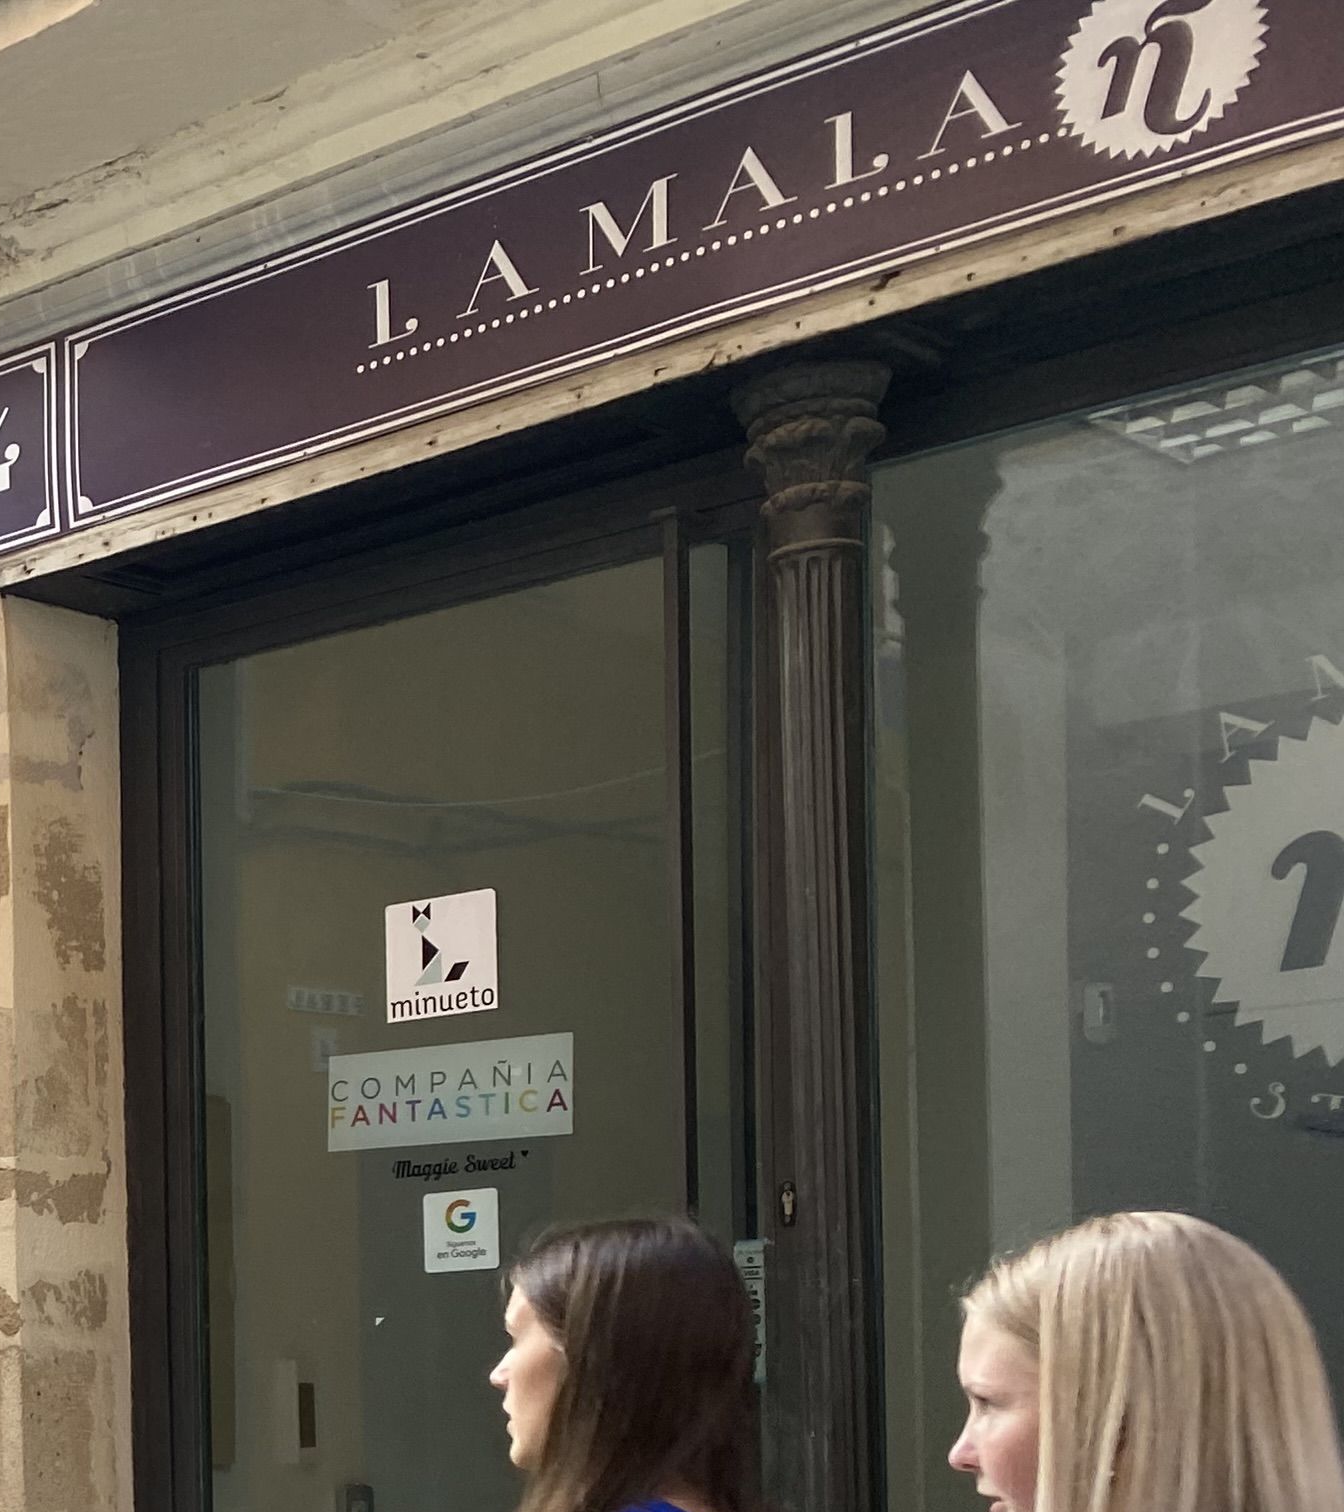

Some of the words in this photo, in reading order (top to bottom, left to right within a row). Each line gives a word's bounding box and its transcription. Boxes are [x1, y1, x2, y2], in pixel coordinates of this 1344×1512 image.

[367, 238, 539, 349] LA
[579, 69, 1024, 277] MALA
[390, 984, 496, 1020] minueto
[330, 1059, 569, 1103] COMPAÑIA
[329, 1087, 569, 1130] FANTASTICA
[392, 1157, 458, 1182] Maggie
[466, 1150, 517, 1174] Sweet
[450, 1247, 487, 1259] Google
